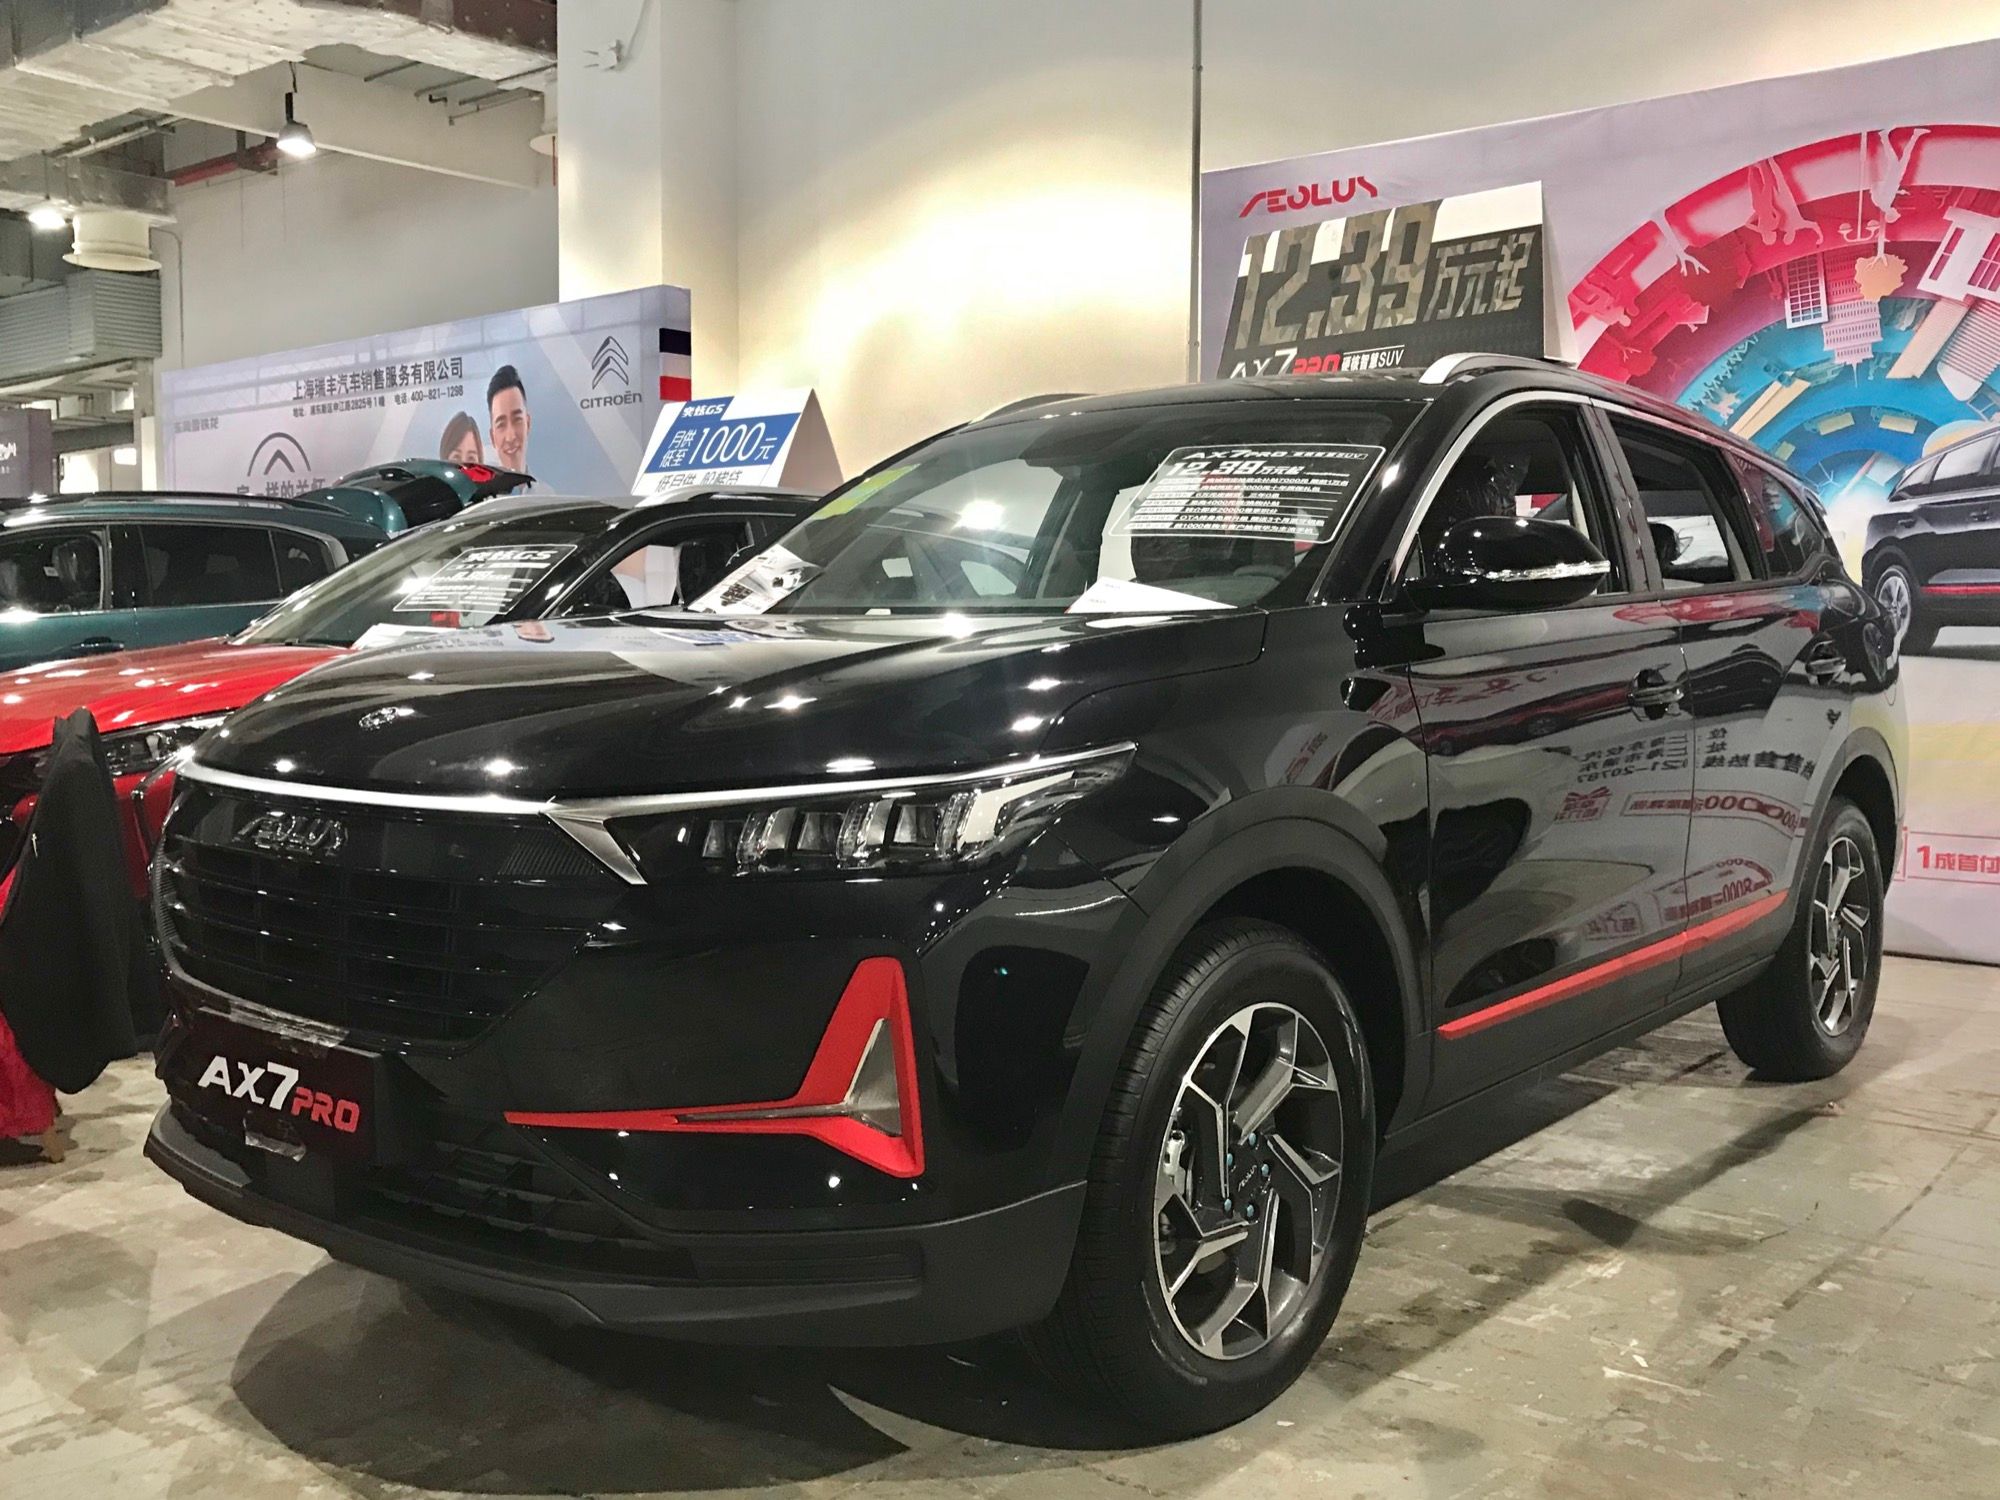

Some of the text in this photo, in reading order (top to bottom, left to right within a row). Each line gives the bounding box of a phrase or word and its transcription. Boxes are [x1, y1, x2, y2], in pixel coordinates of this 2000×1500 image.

[293, 357, 463, 401] 上海瑞丰汽车销售服务有限公司
[580, 391, 642, 410] CITROËN
[669, 429, 697, 449] 月供
[659, 447, 688, 468] 低至
